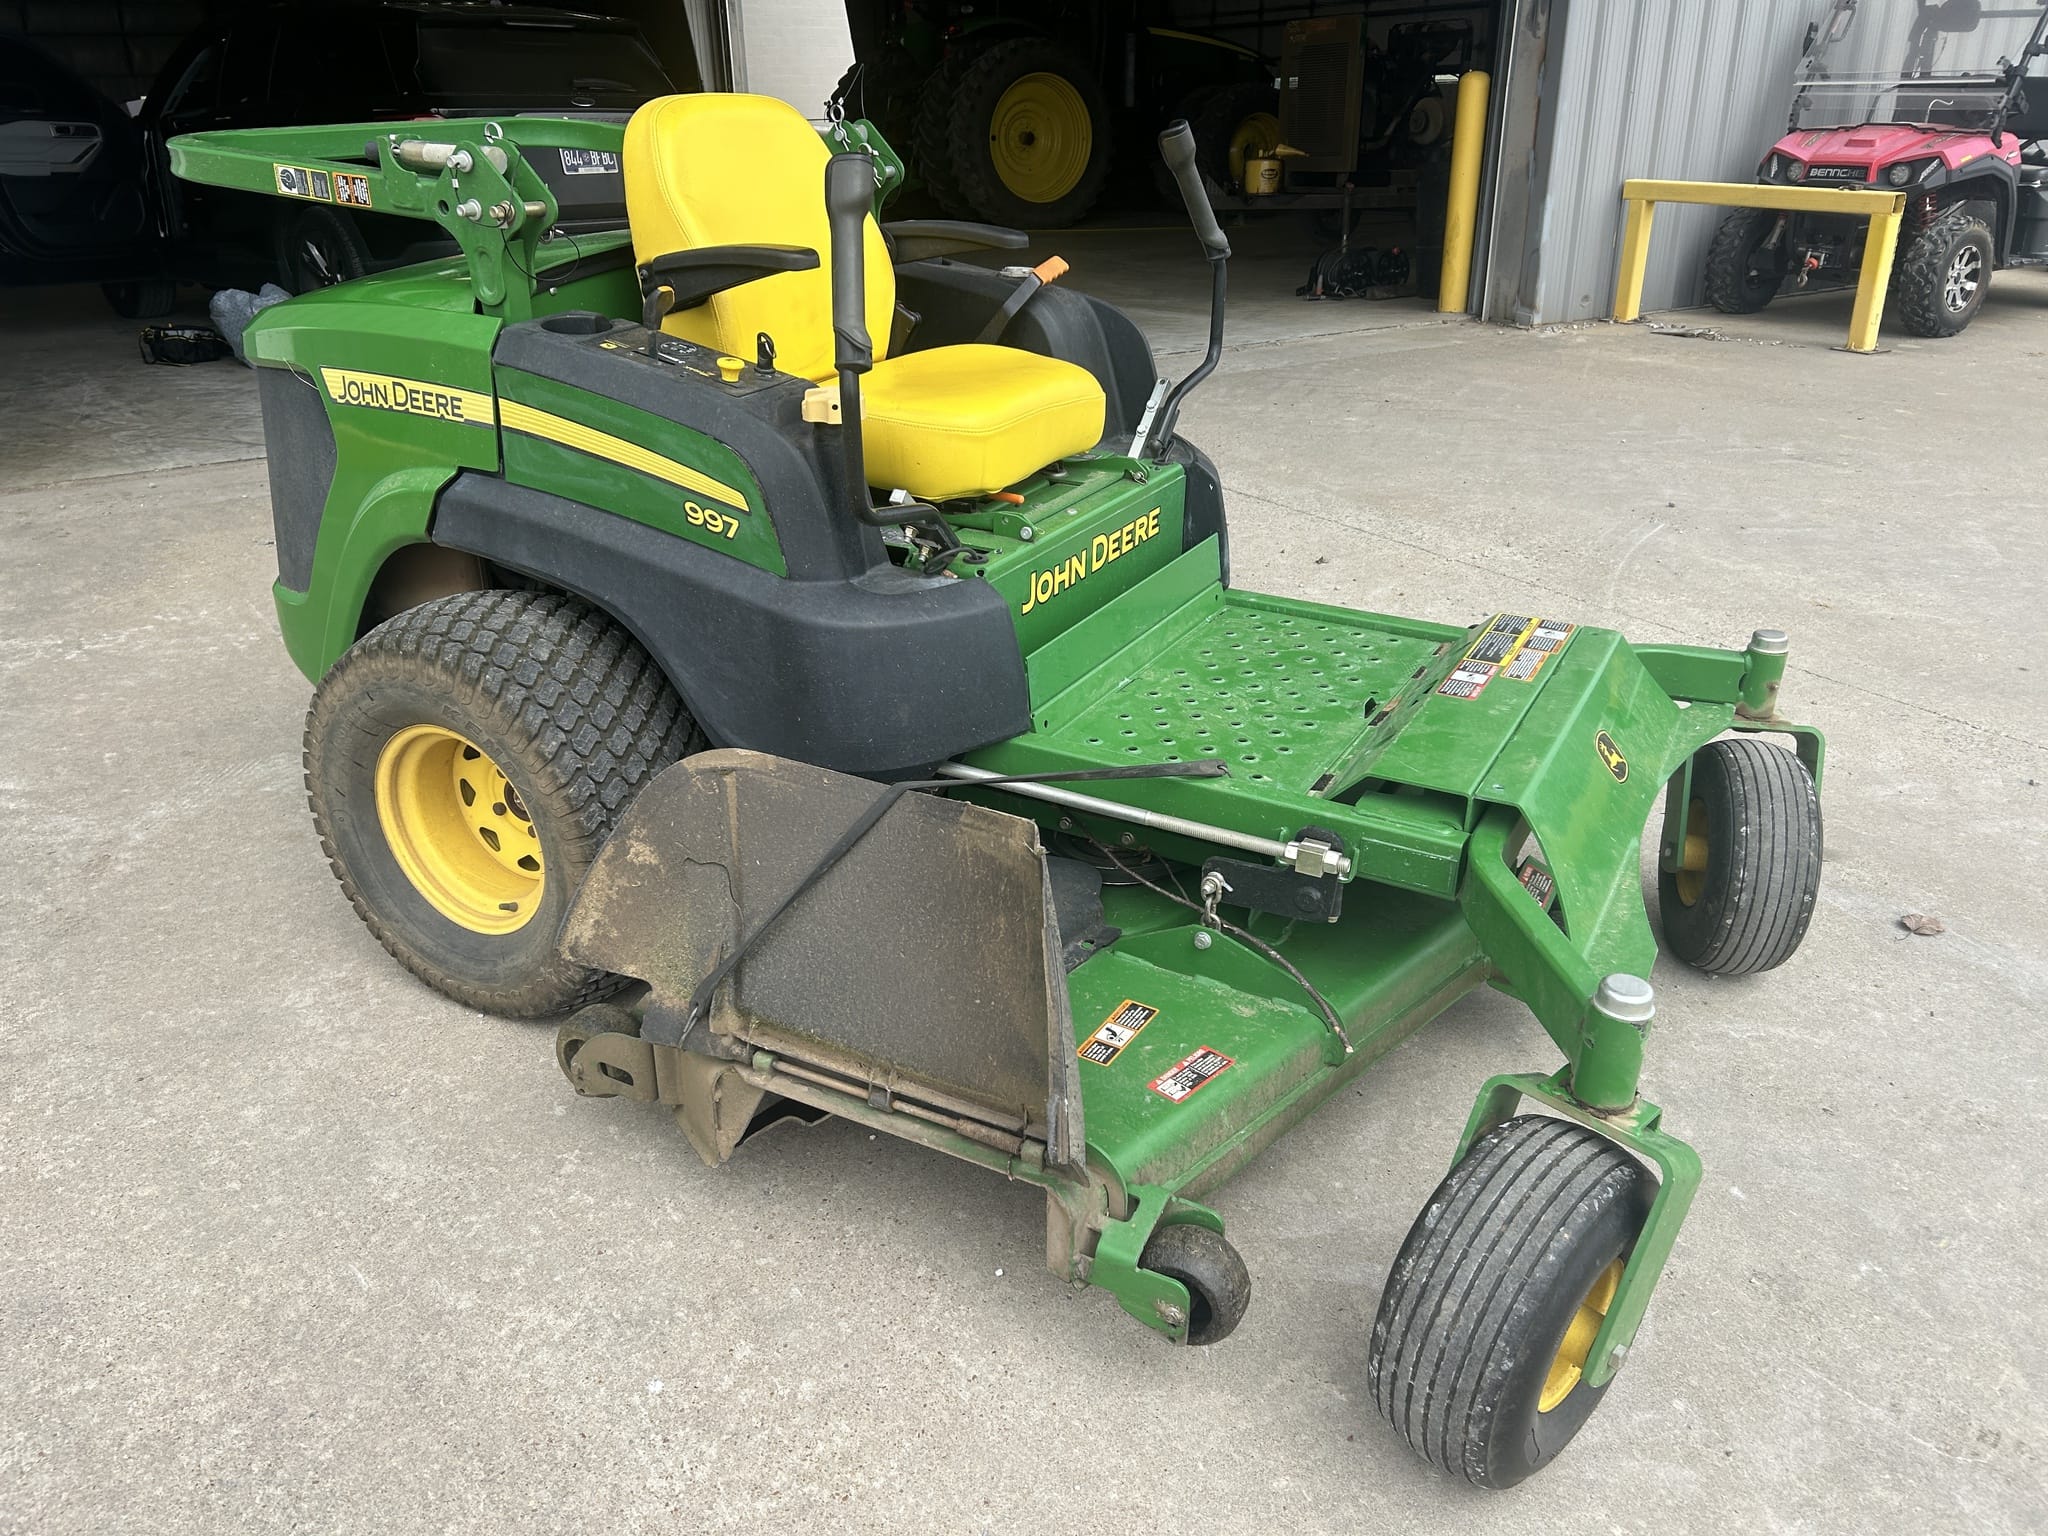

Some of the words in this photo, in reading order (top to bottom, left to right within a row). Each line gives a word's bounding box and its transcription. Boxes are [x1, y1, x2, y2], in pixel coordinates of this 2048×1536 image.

[337, 375, 389, 408] JOHN
[392, 380, 464, 419] DEERE
[684, 501, 741, 540] 997
[1021, 549, 1087, 615] JOHN
[1091, 506, 1161, 574] DEERE
